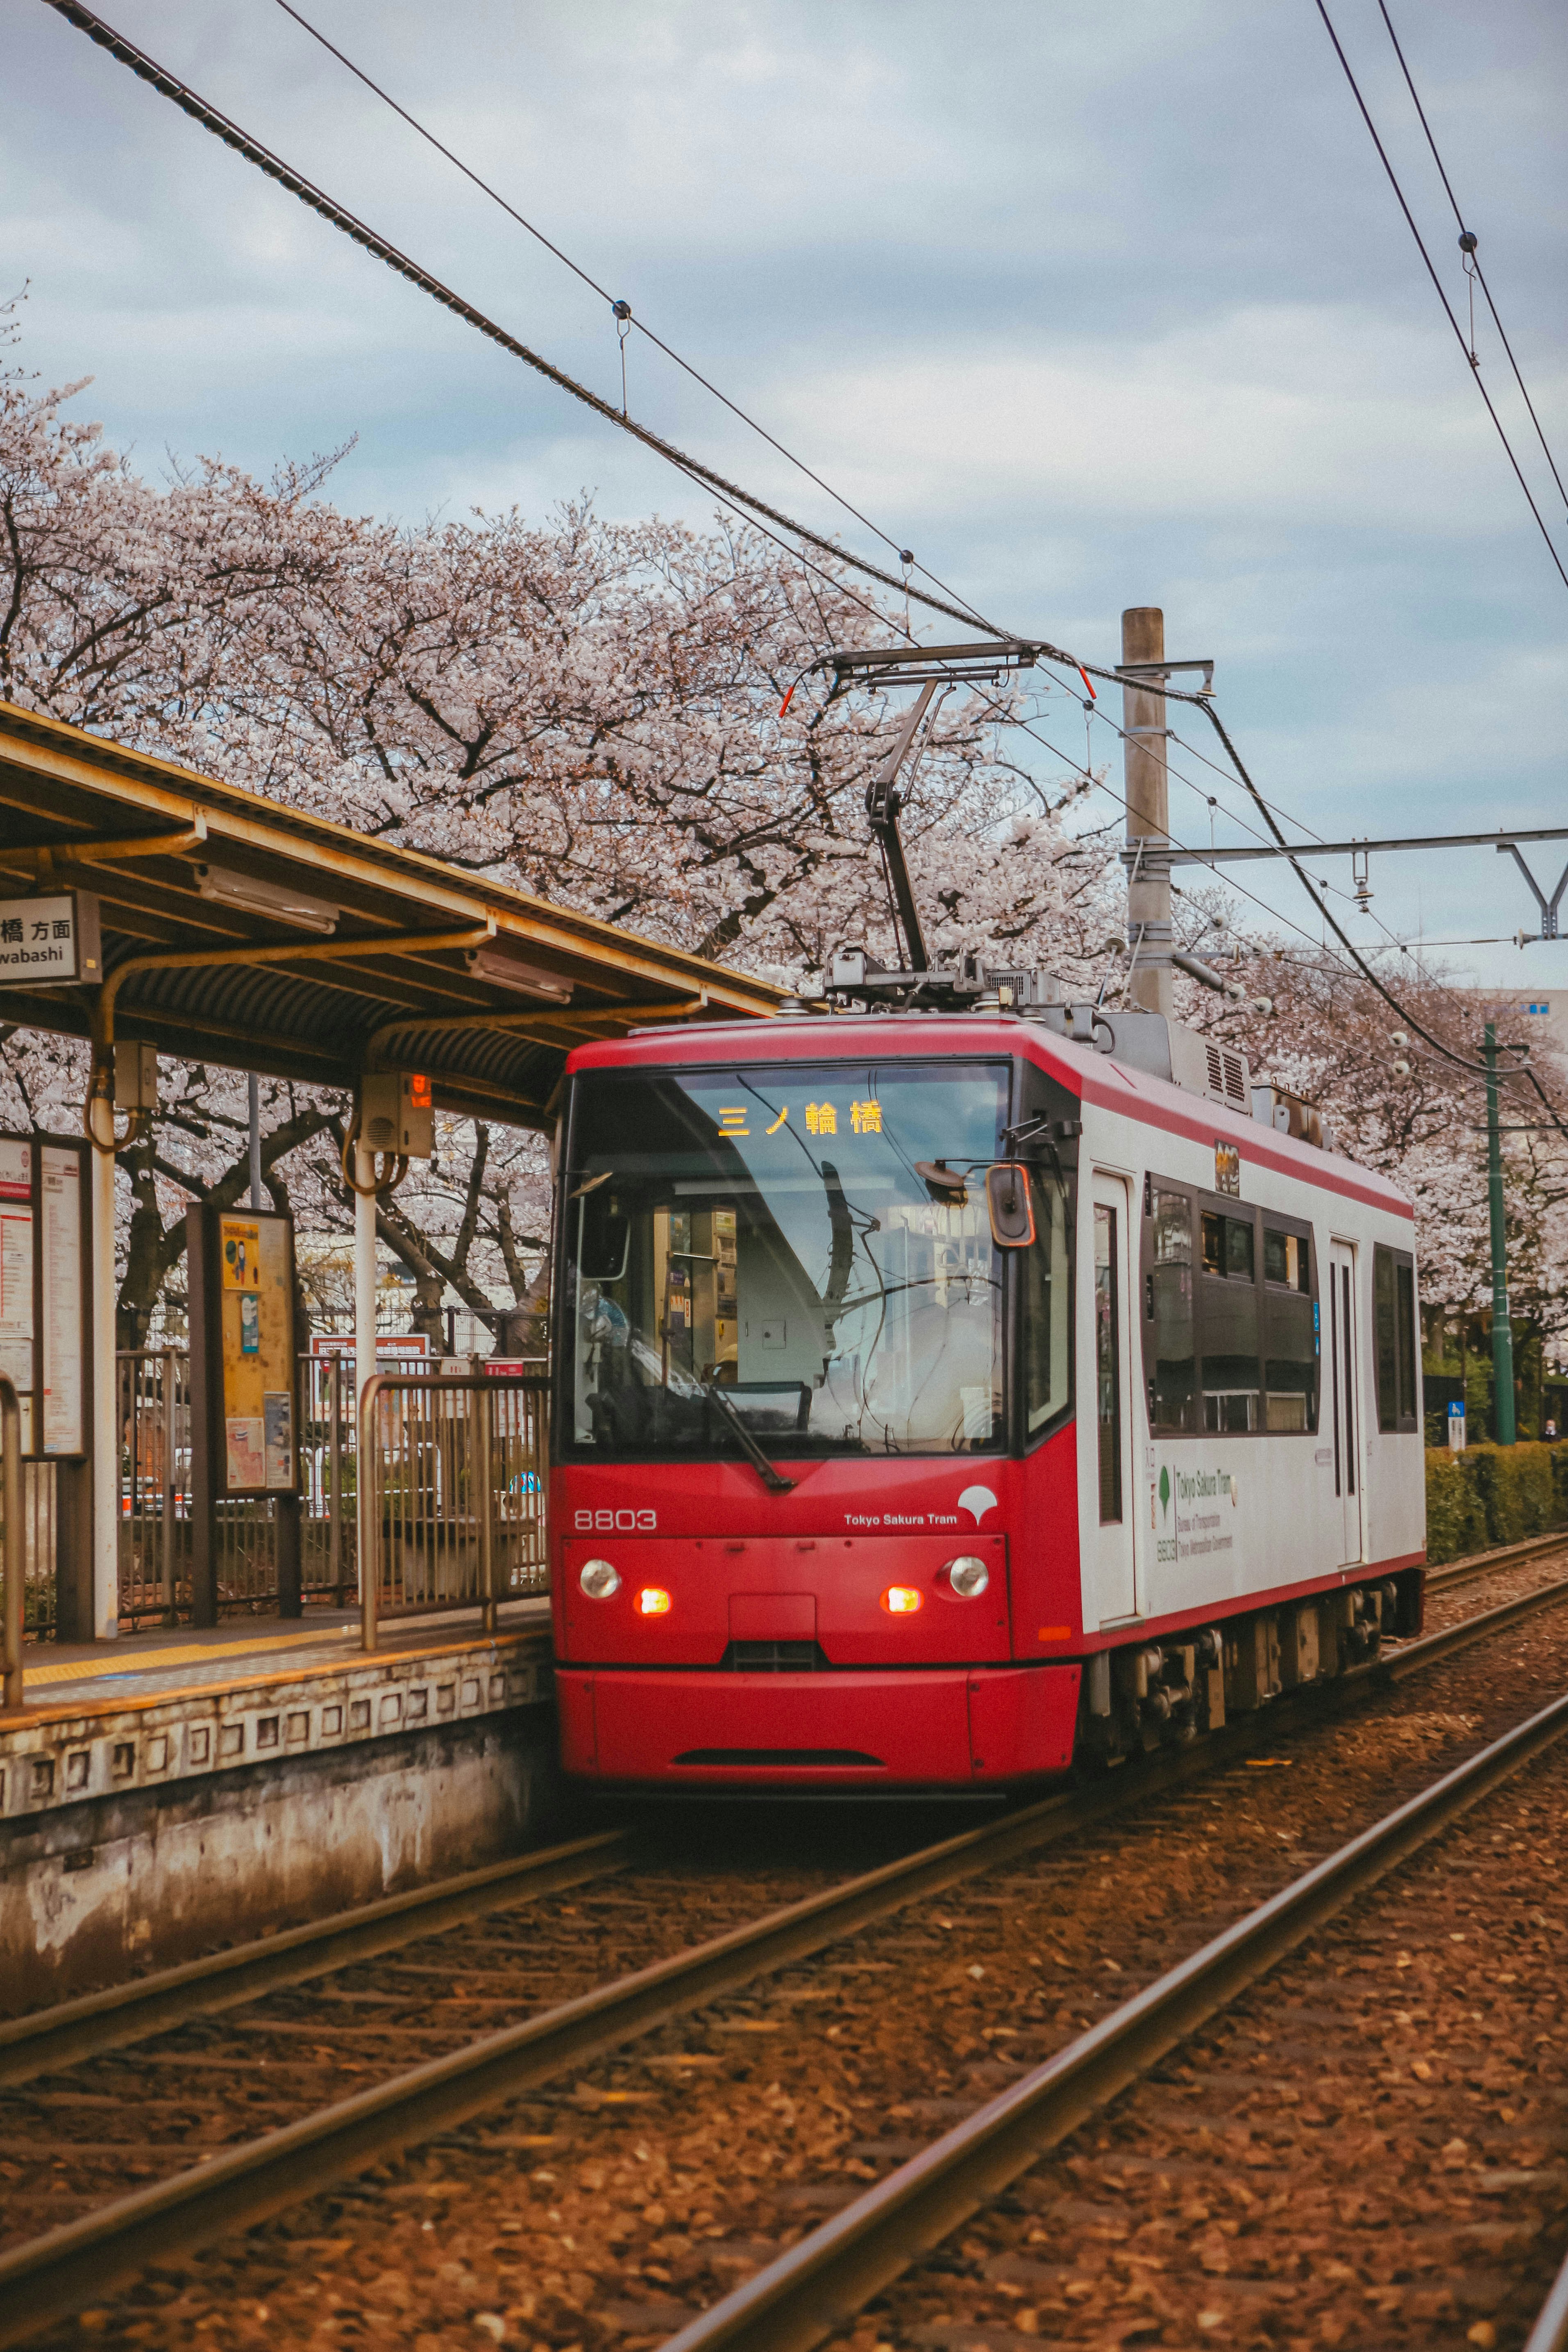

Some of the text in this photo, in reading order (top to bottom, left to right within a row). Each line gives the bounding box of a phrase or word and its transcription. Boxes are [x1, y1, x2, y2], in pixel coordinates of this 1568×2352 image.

[0, 946, 62, 964] wabashi
[718, 1100, 882, 1136] 三ノ輪橋
[1177, 1468, 1231, 1506] Tokyo Sakura Tram
[575, 1510, 657, 1530] 8803
[844, 1513, 957, 1527] Tokyo Sakura Tram
